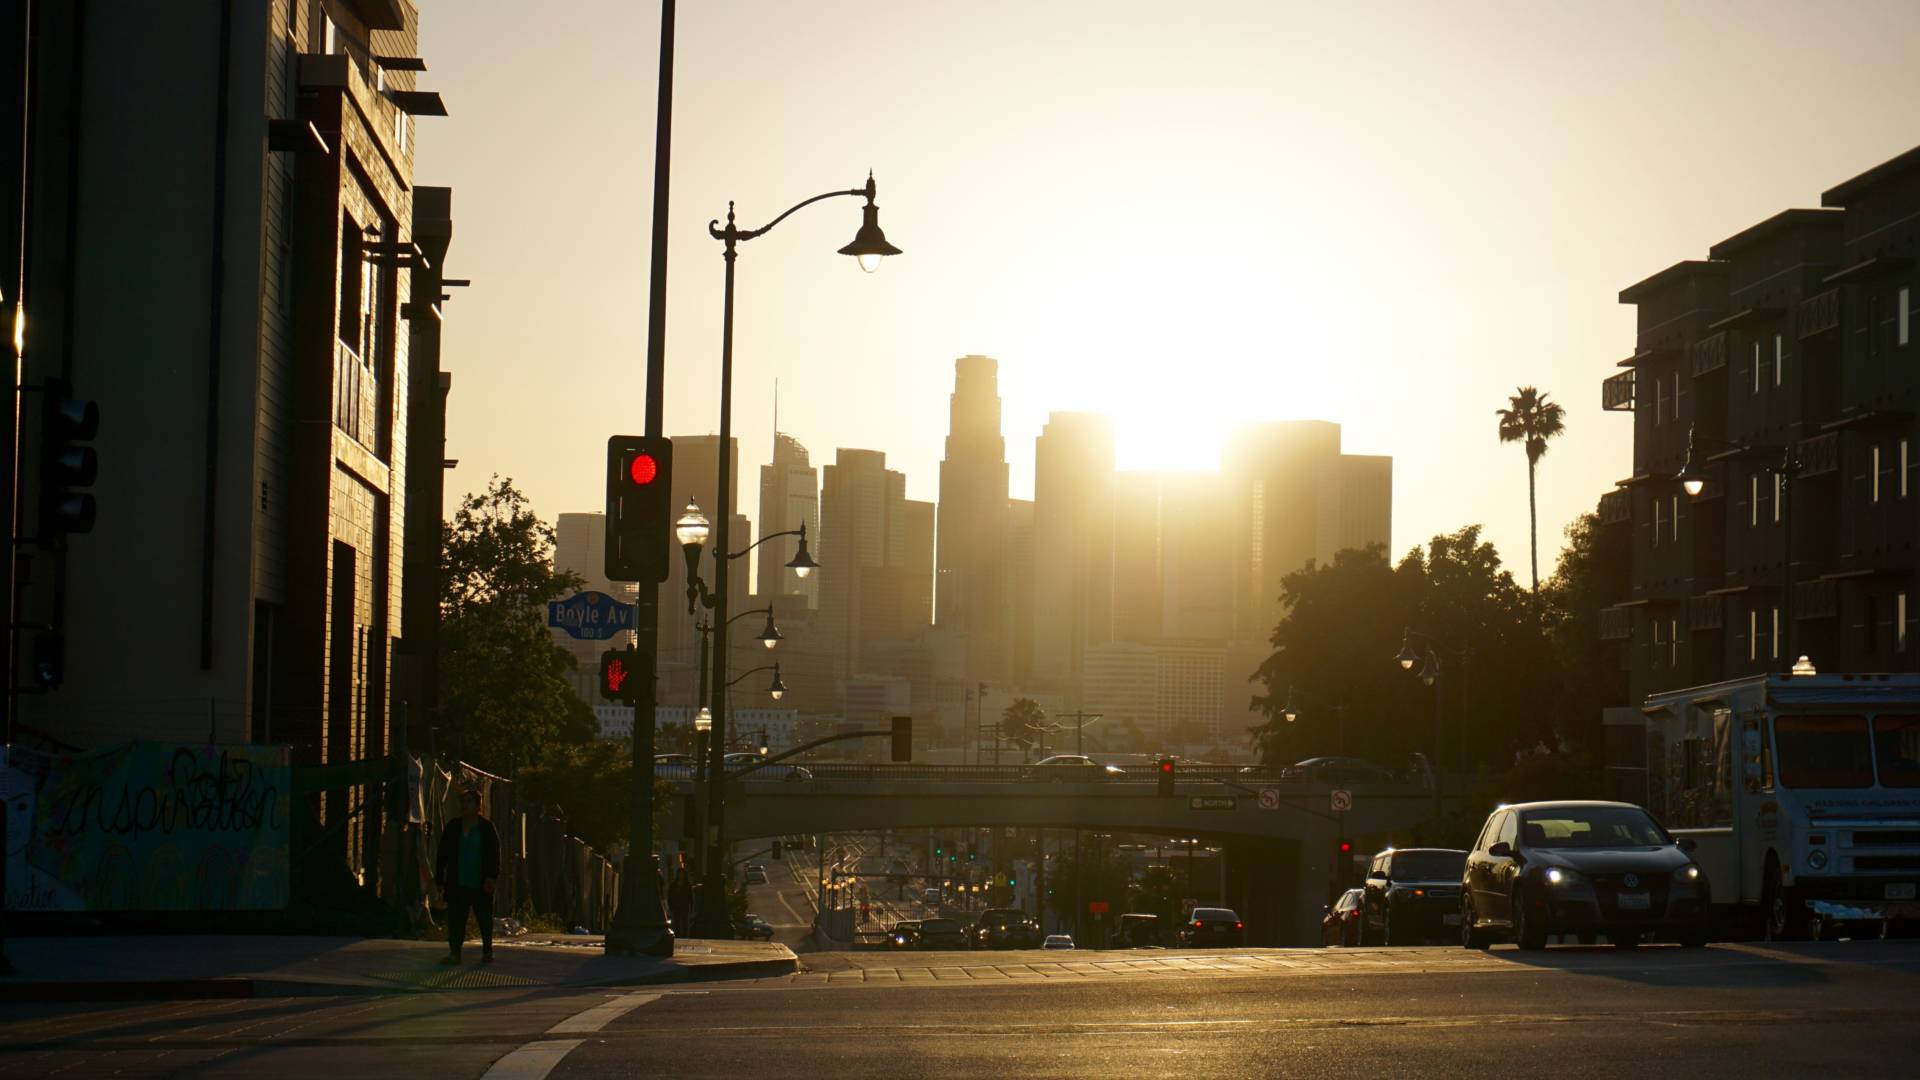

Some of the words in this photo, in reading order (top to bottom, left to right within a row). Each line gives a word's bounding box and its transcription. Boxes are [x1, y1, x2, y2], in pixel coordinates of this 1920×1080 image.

[556, 604, 599, 628] Boyle
[607, 606, 628, 625] Av
[1203, 799, 1227, 808] NORTH
